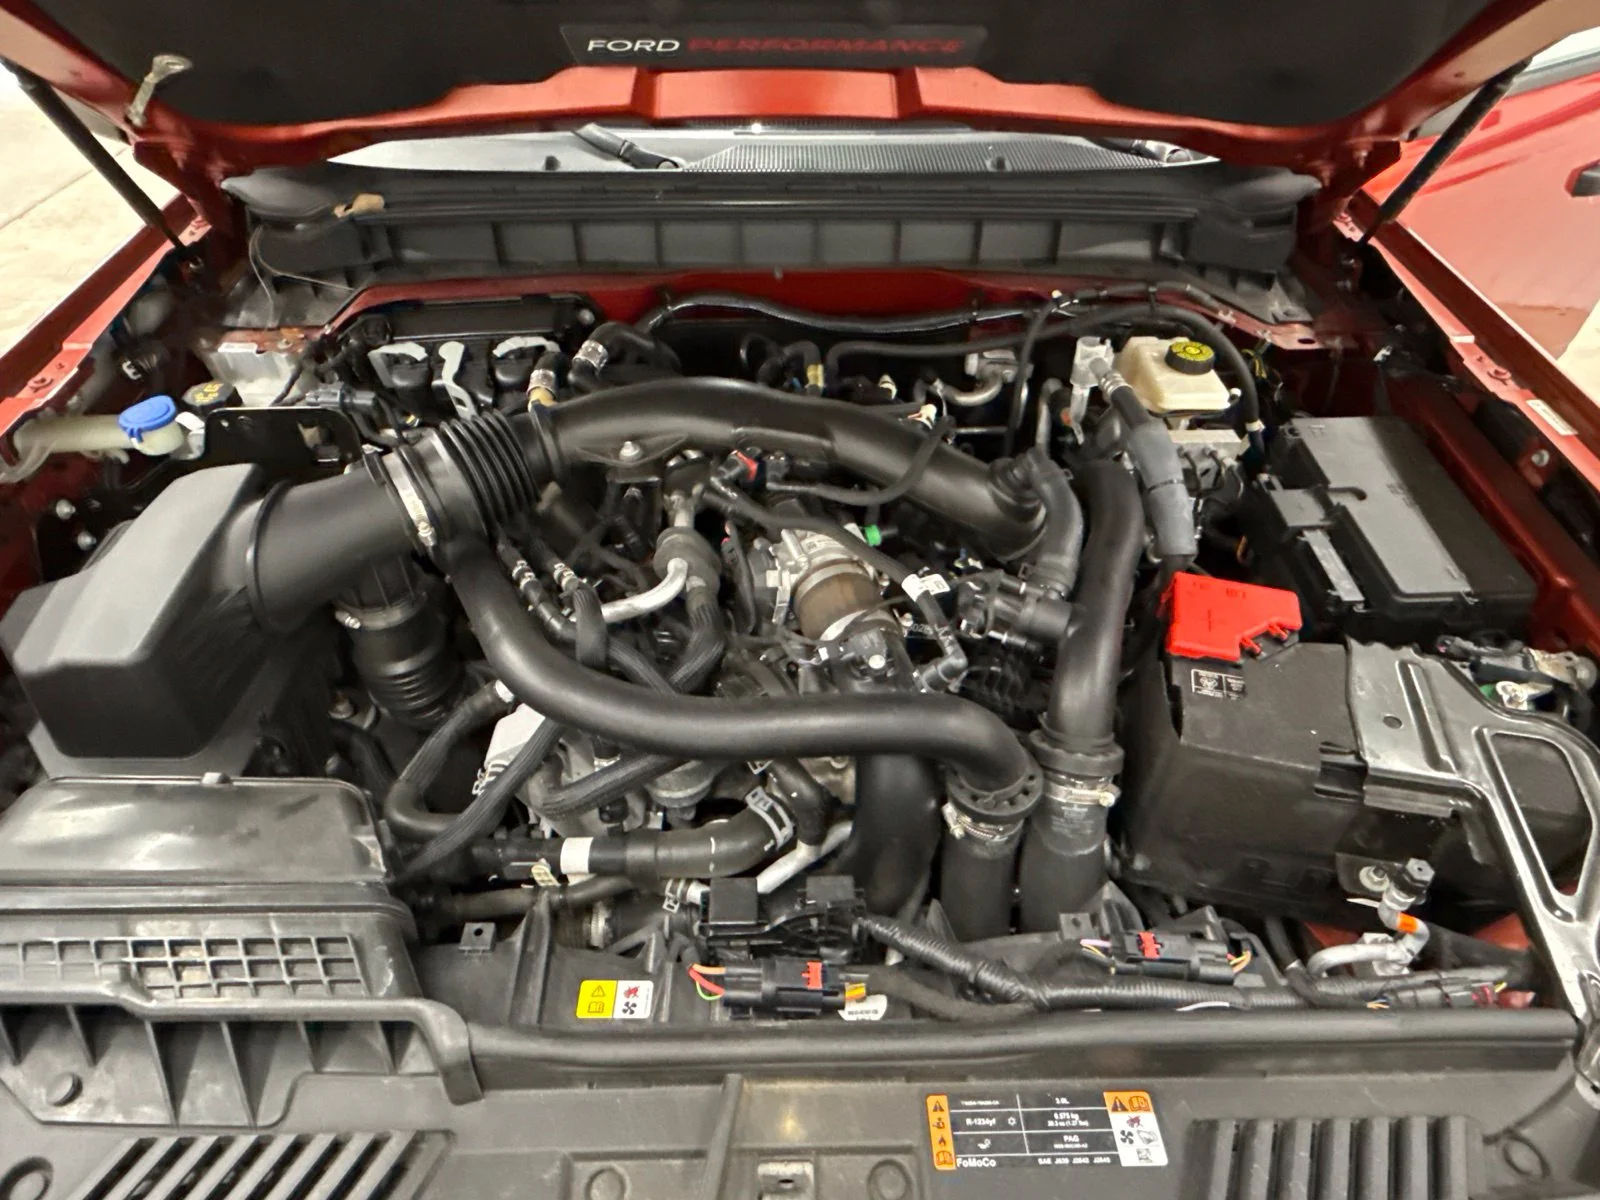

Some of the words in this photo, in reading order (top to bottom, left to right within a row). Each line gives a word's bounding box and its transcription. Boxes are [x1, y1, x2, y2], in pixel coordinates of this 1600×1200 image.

[587, 39, 681, 52] FORD
[687, 37, 966, 53] PERFORMANCE
[965, 1117, 996, 1127] R-1234yf
[1063, 1134, 1080, 1142] PAG
[957, 1157, 997, 1168] FoMoCo
